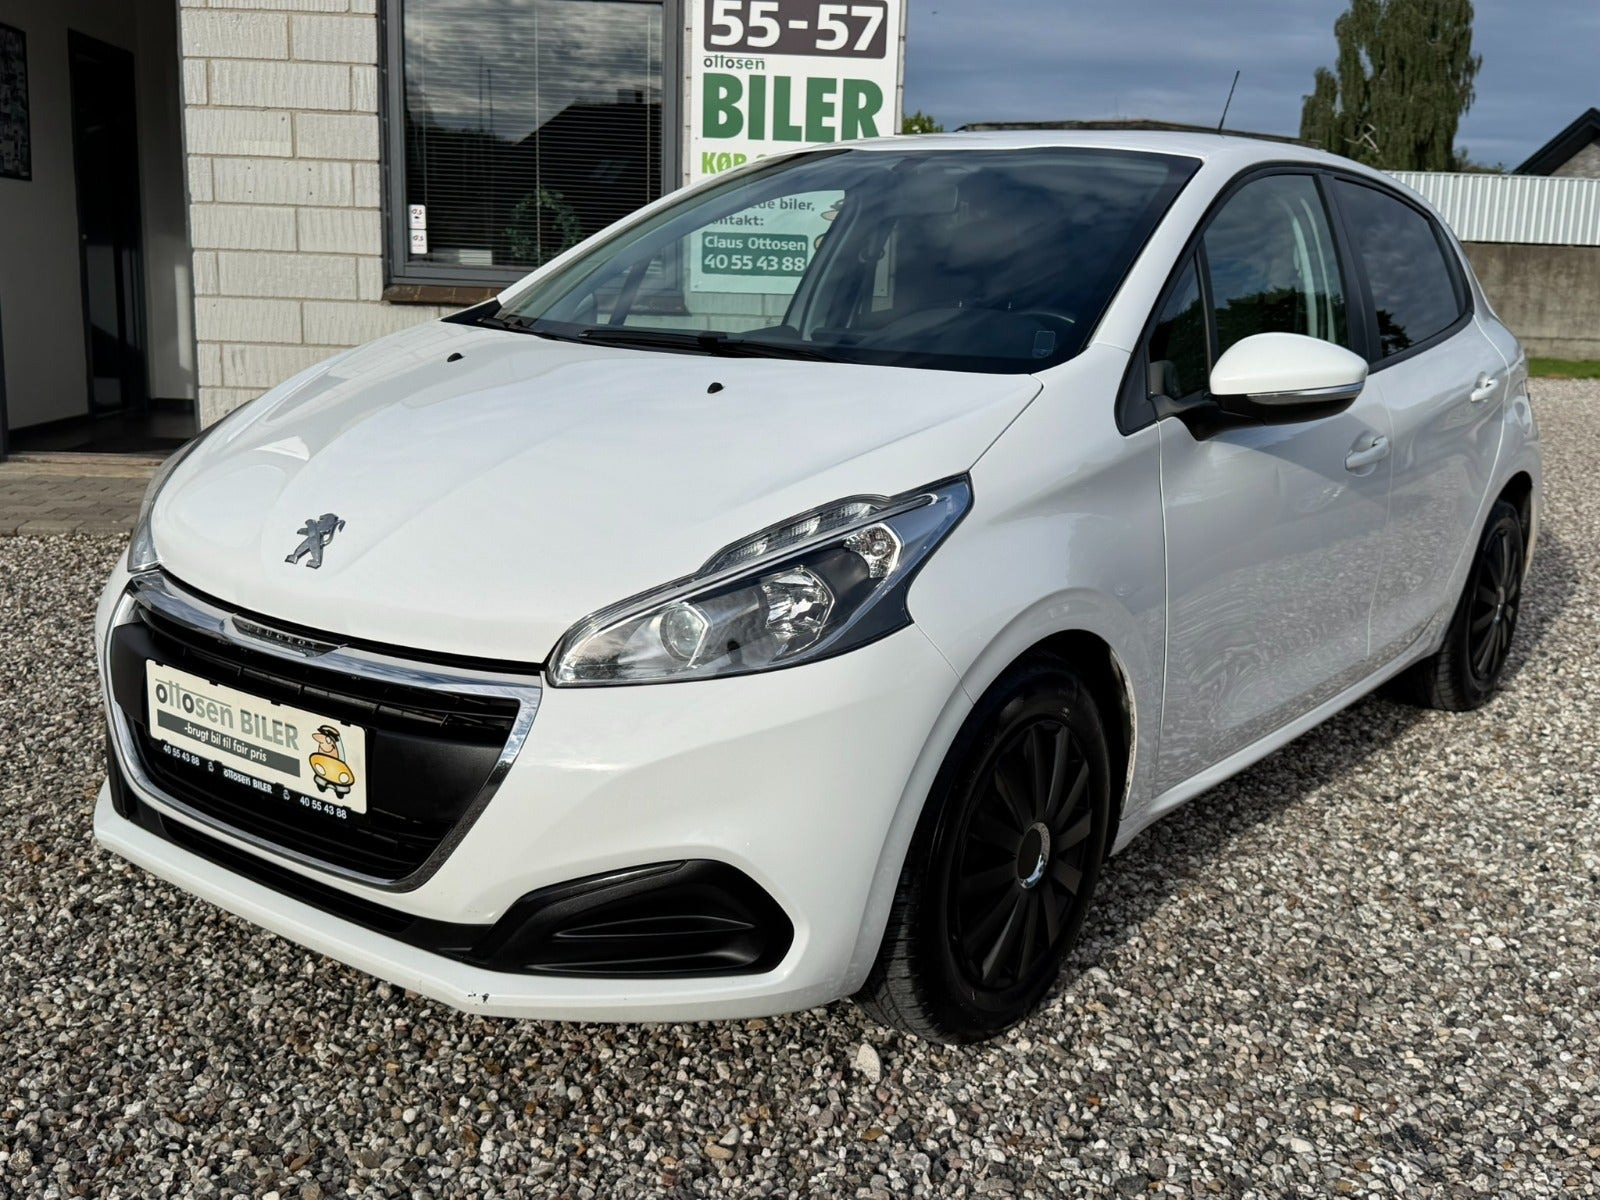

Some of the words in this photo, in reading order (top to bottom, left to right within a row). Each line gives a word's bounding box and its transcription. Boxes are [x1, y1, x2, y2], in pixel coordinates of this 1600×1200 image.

[710, 0, 884, 51] 55-57
[702, 73, 883, 142] BILER
[711, 215, 764, 226] ontakt:
[704, 236, 743, 249] Claus
[747, 237, 806, 251] Ottosen
[704, 254, 728, 269] 40
[730, 255, 753, 270] 55
[756, 256, 779, 271] 43
[781, 257, 806, 271] 88
[154, 679, 234, 729] ottosen
[240, 709, 299, 751] BILER
[163, 744, 171, 754] 40
[172, 747, 180, 758] 55
[181, 752, 190, 762] 43
[191, 755, 200, 766] 88
[211, 730, 221, 745] bil
[222, 736, 232, 750] til
[233, 740, 248, 755] fair
[250, 749, 267, 761] pris
[252, 779, 272, 794] BILER
[300, 796, 310, 807] 40
[311, 799, 321, 811] 55
[323, 804, 334, 815] 43
[336, 808, 347, 819] 88
